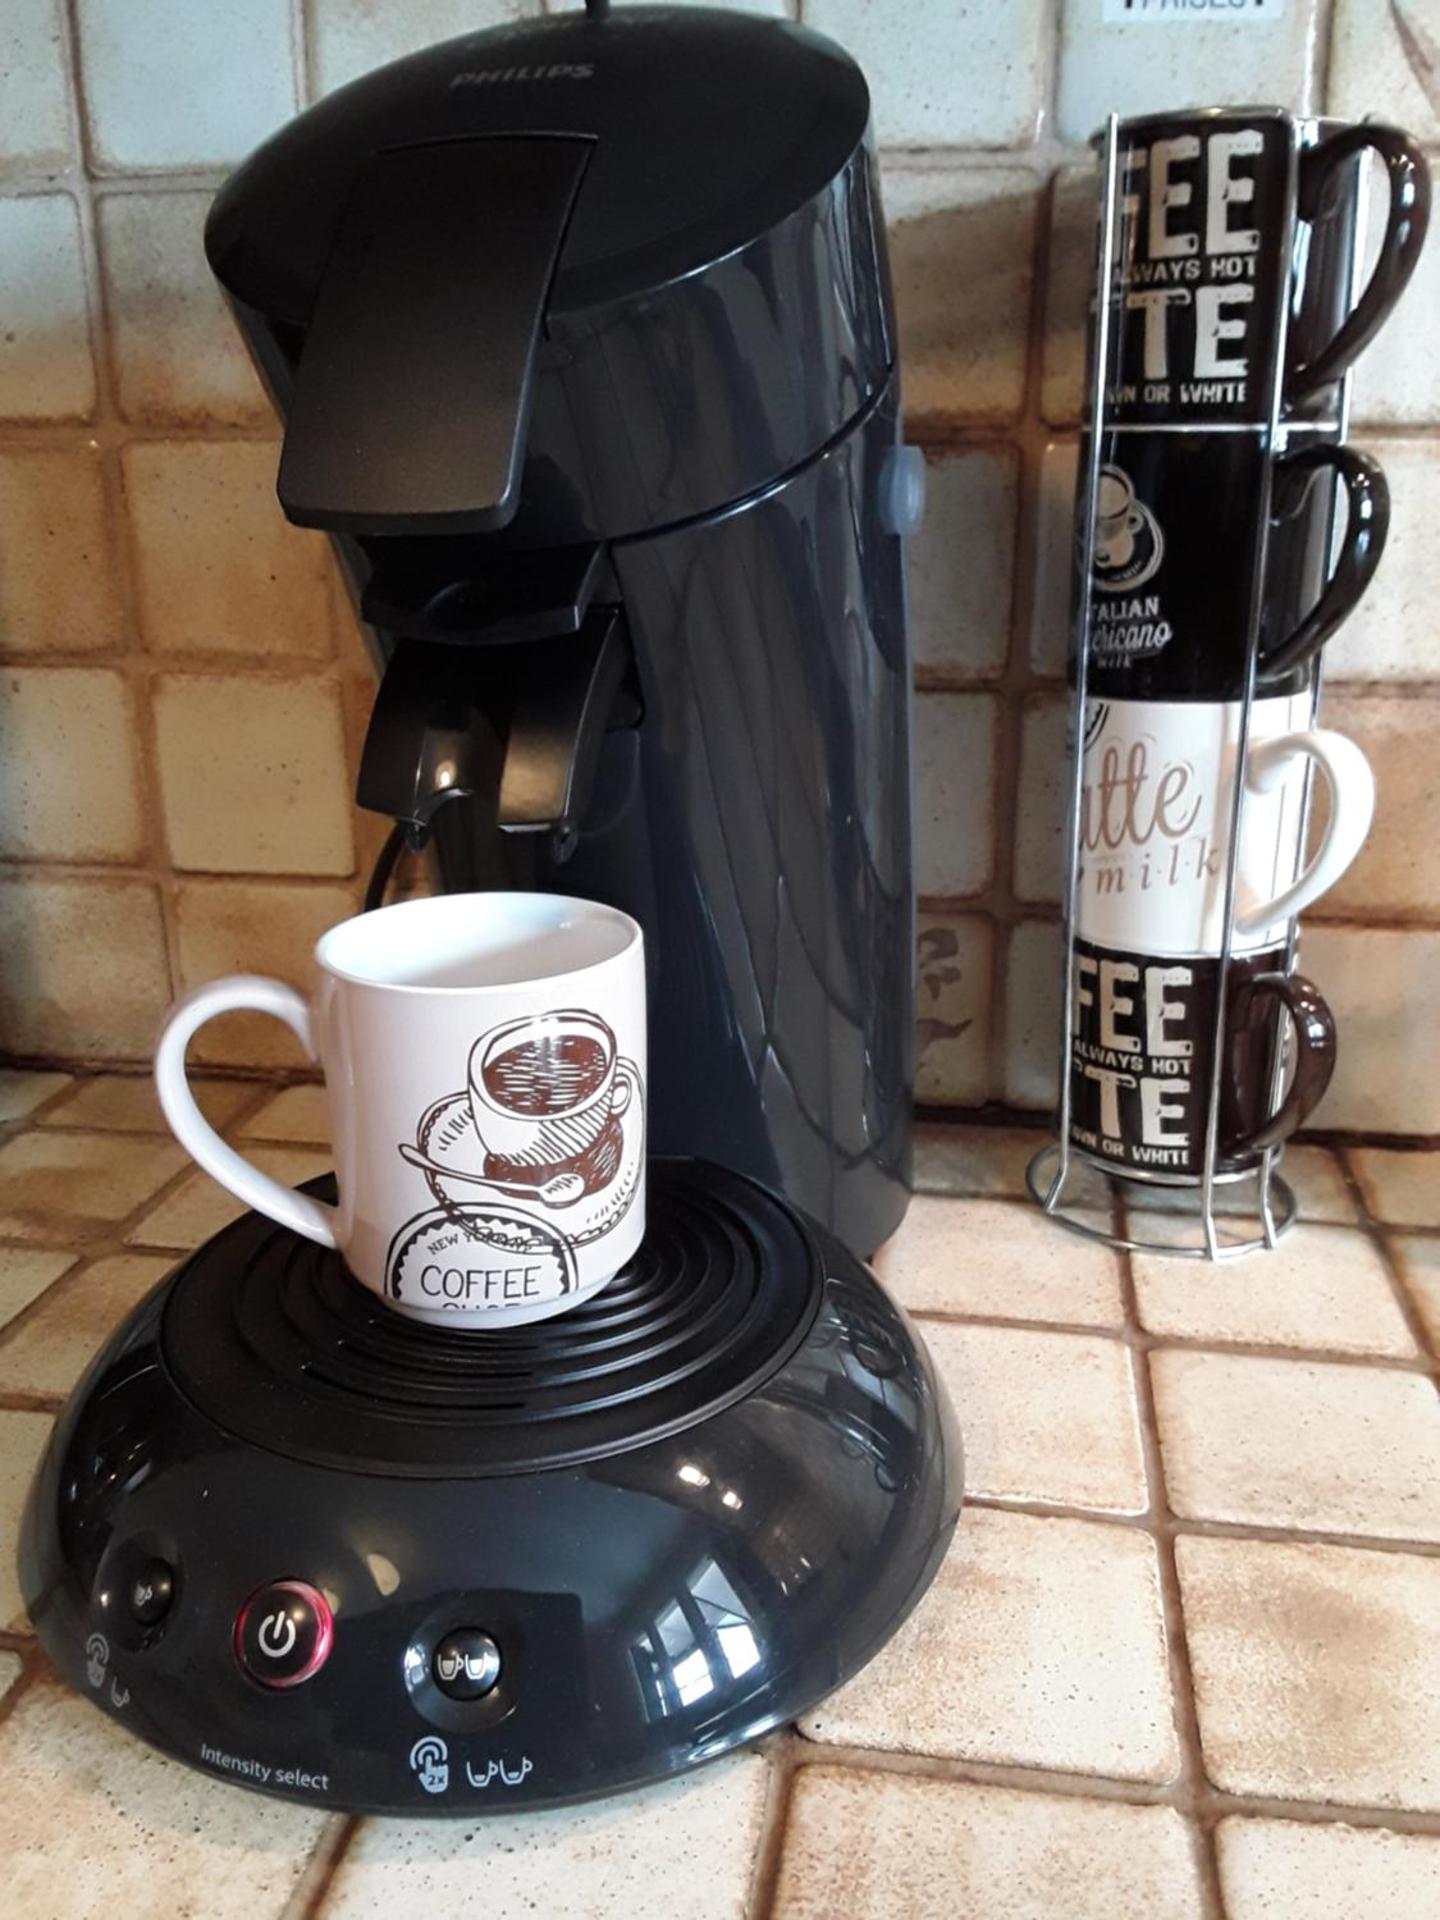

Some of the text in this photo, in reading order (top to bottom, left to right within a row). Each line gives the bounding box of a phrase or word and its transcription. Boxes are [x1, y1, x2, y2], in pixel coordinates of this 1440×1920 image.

[450, 63, 595, 88] PHILIPS
[1210, 256, 1257, 279] HOT
[1122, 282, 1255, 380] TE
[1144, 383, 1171, 403] OR
[1180, 382, 1247, 403] WHITE
[1093, 596, 1160, 621] ALIAN
[1096, 838, 1219, 894] milk
[1152, 1058, 1192, 1076] HOT
[1084, 1064, 1191, 1147] TE
[1102, 1138, 1125, 1158] OR
[426, 1233, 459, 1256] NEW
[420, 1264, 542, 1300] COFFEE
[200, 1743, 330, 1792] Intensity select
